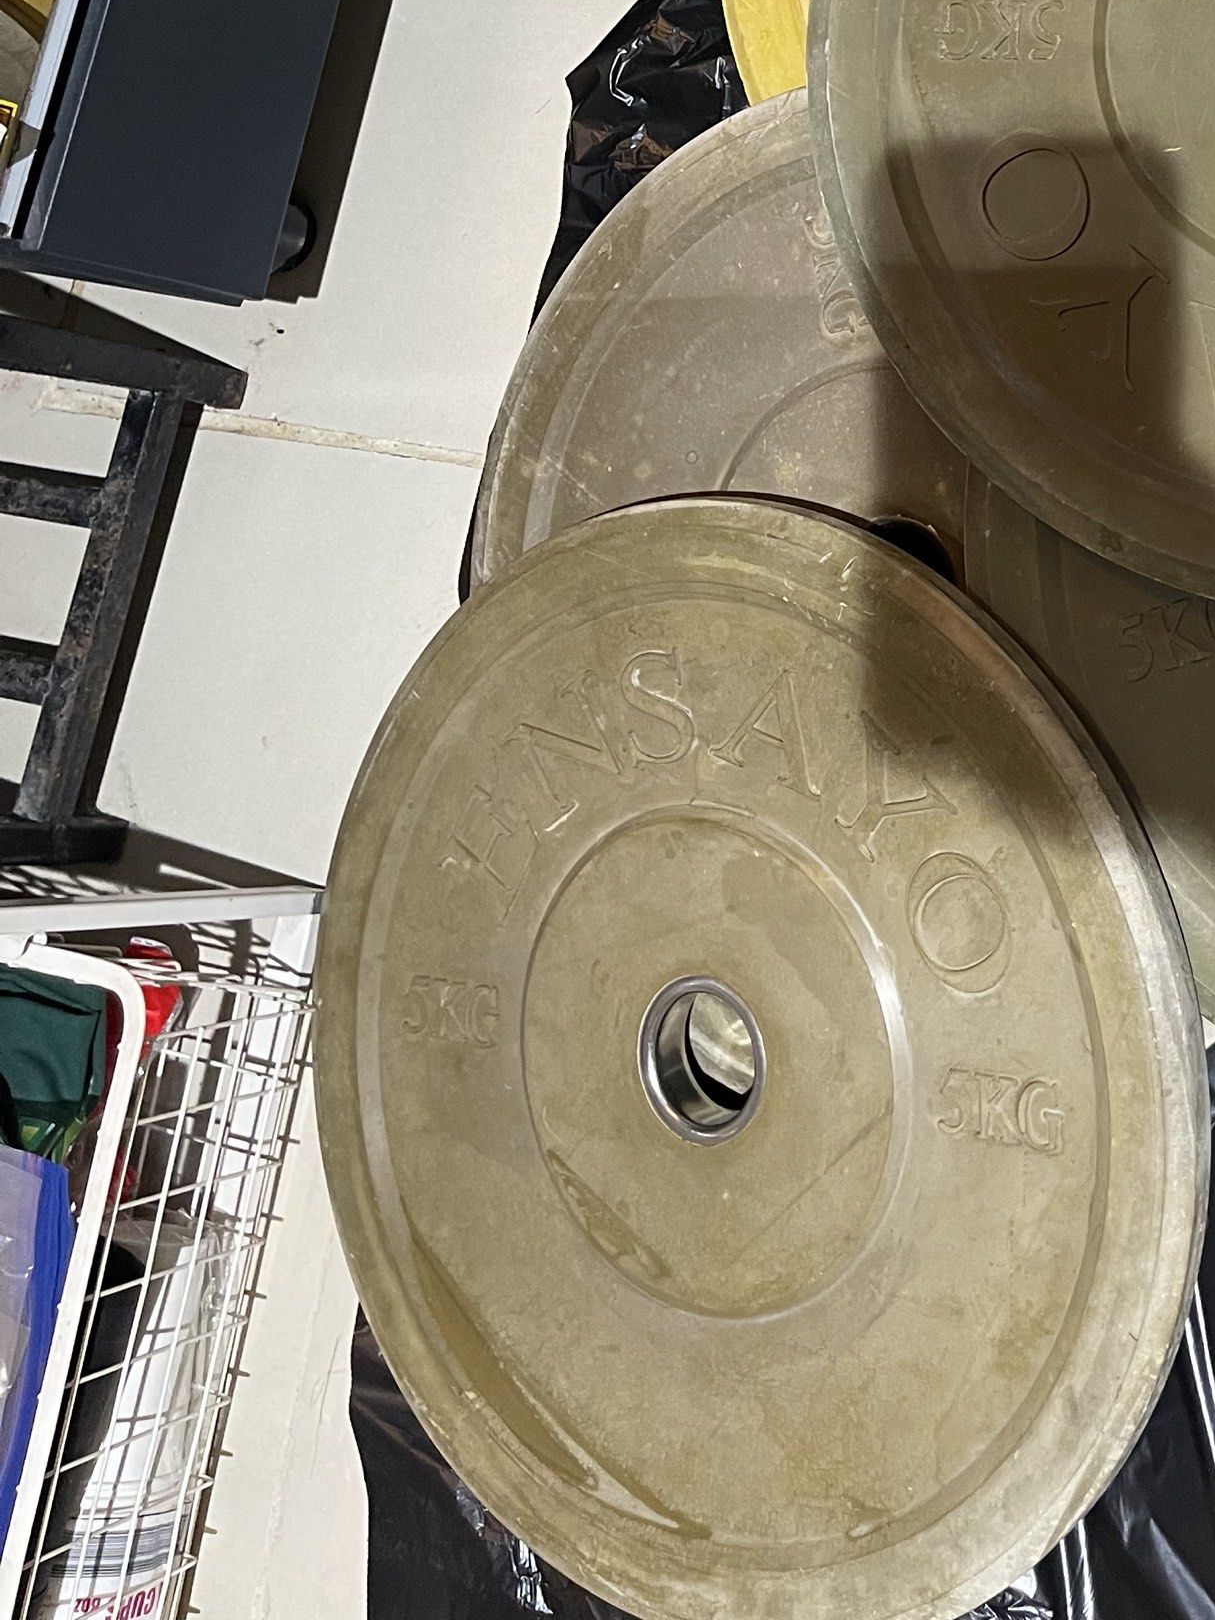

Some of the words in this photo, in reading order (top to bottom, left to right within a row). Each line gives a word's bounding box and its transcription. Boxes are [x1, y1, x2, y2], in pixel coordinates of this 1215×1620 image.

[439, 648, 1011, 995] ENSAYO
[402, 974, 500, 1049] 5KG
[937, 1067, 1065, 1154] 5KG
